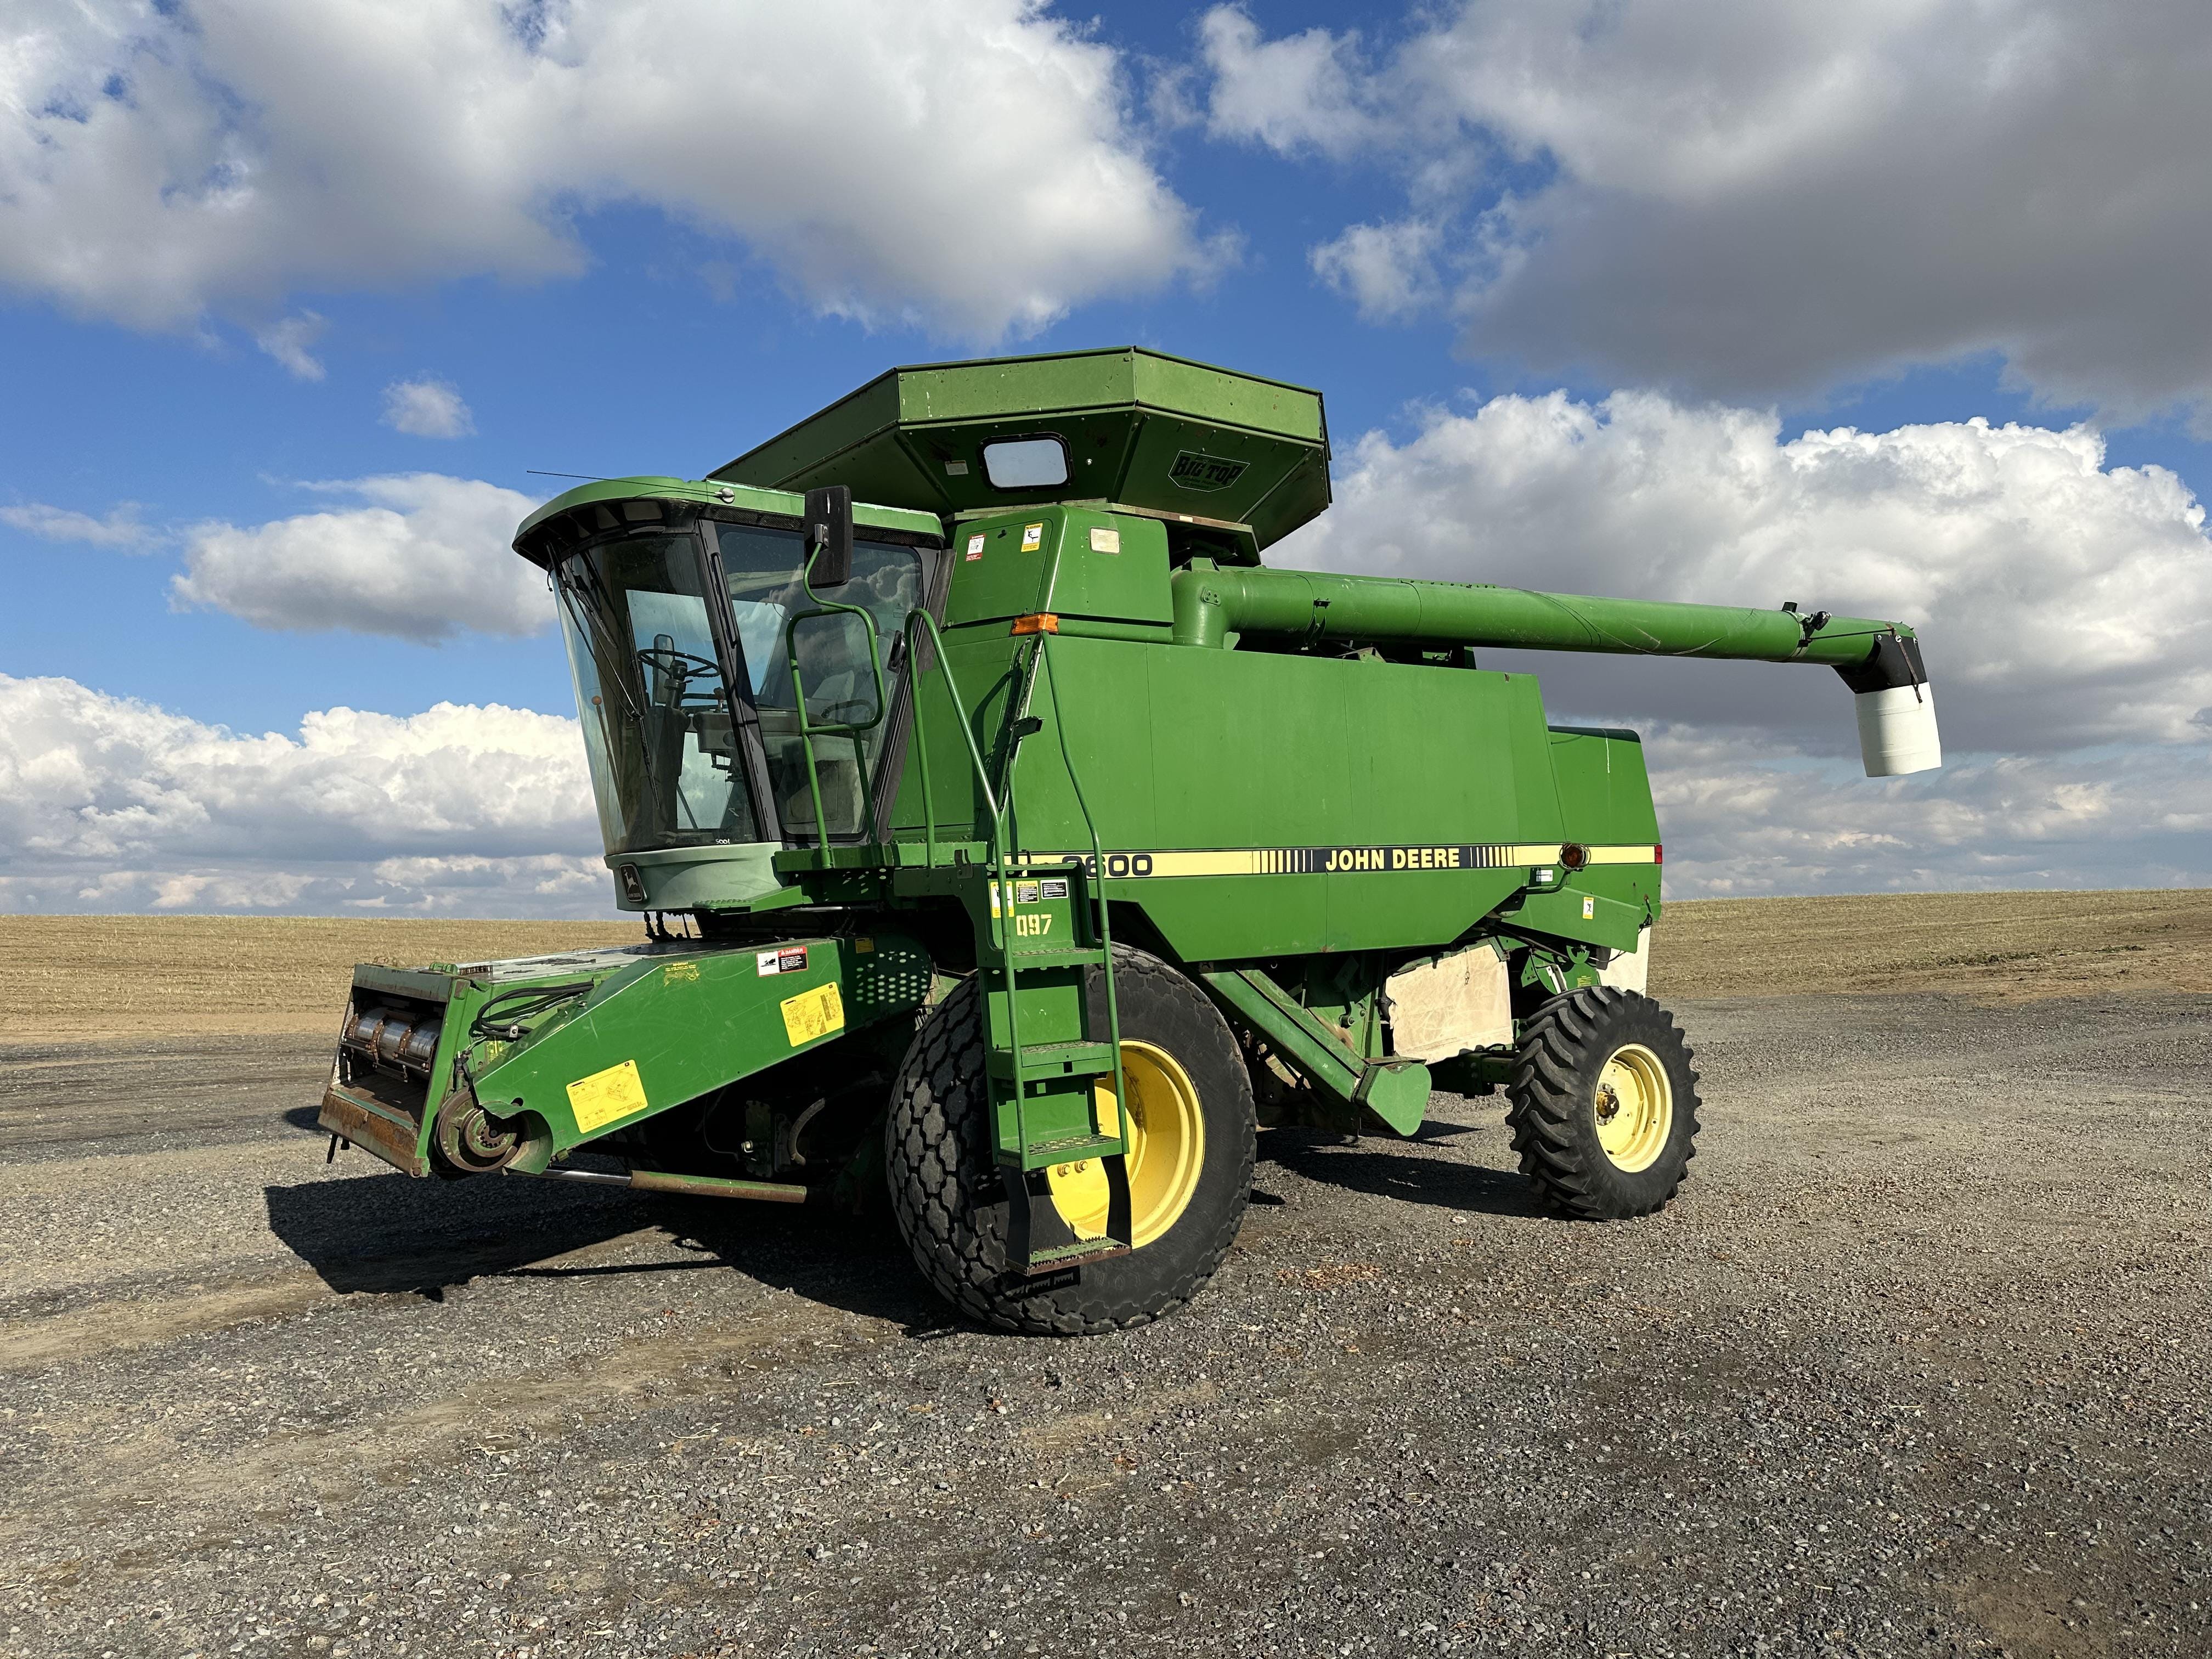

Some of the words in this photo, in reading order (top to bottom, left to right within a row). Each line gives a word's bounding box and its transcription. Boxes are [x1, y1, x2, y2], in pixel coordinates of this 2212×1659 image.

[1172, 455, 1207, 477] BIG
[1205, 464, 1244, 486] TOP
[1325, 849, 1384, 871] JOHN
[1392, 848, 1460, 869] DEERE
